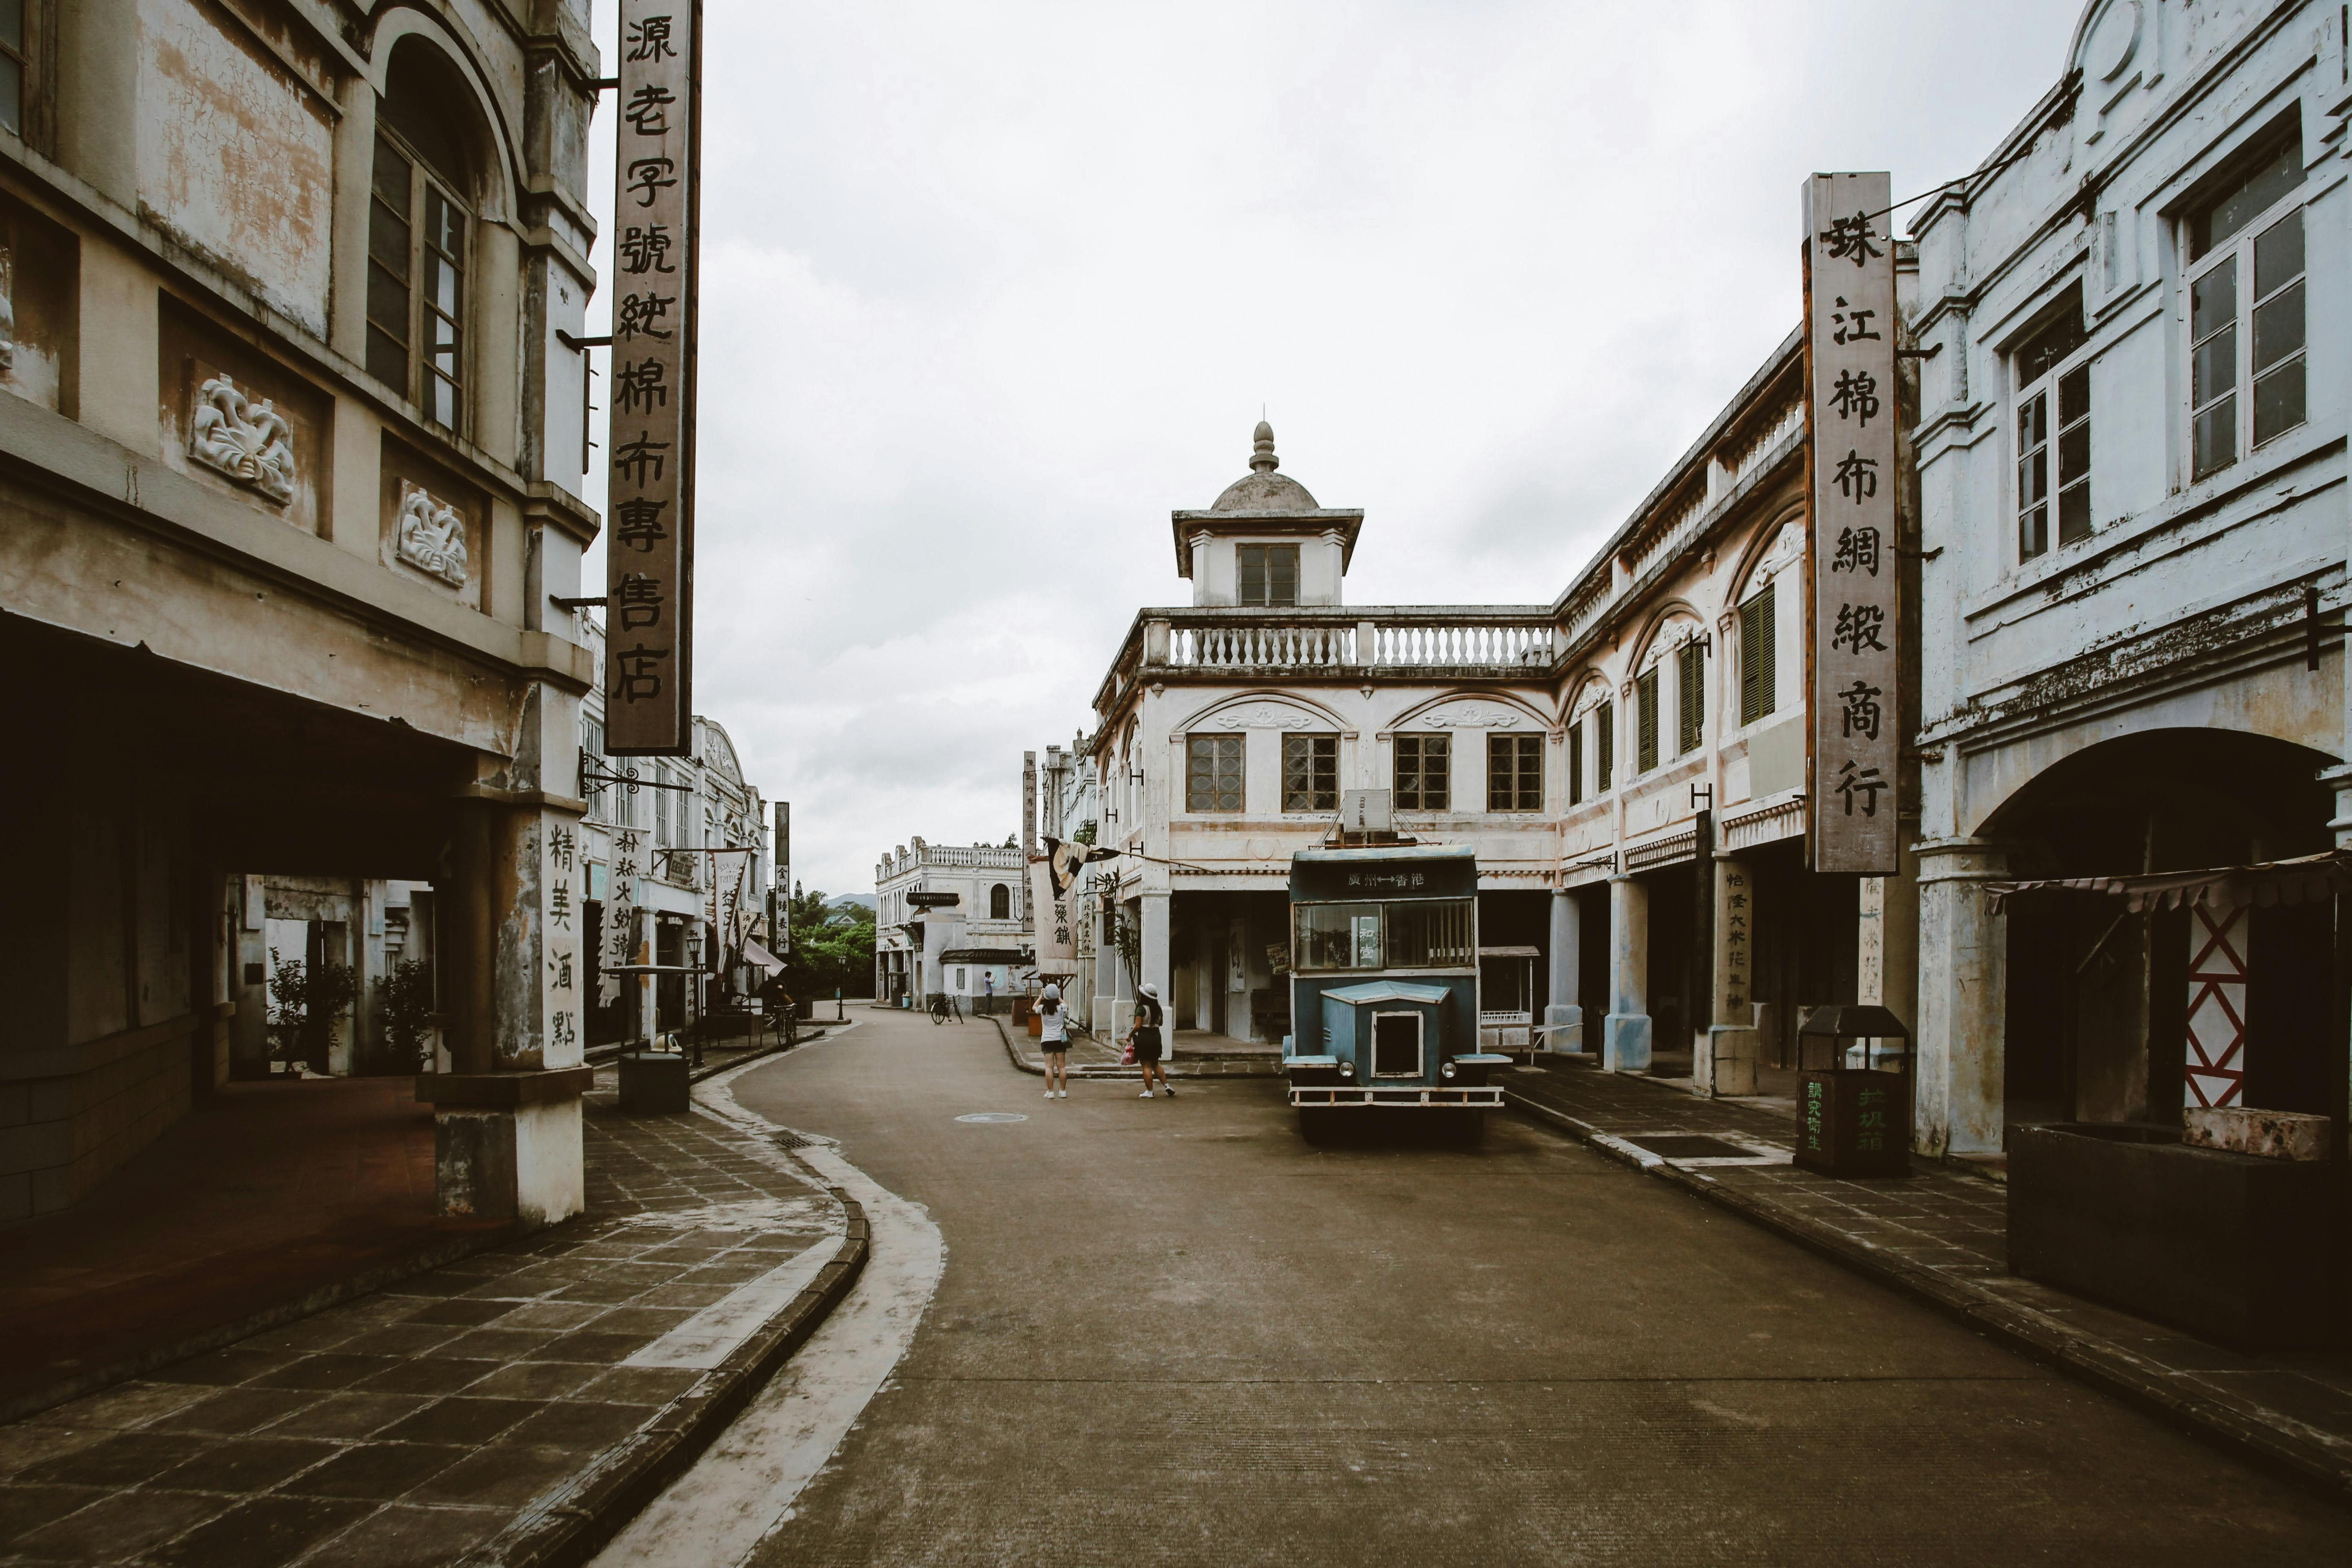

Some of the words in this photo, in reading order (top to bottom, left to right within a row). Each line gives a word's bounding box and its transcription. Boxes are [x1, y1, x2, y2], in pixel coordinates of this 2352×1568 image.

[612, 0, 677, 704] 源老字號純棉布專售店
[1828, 211, 1888, 817] 珠江棉布綢緞商行
[548, 824, 575, 1046] 精美酒點
[1396, 873, 1424, 887] 香港
[1807, 1082, 1822, 1151] 講究衛生
